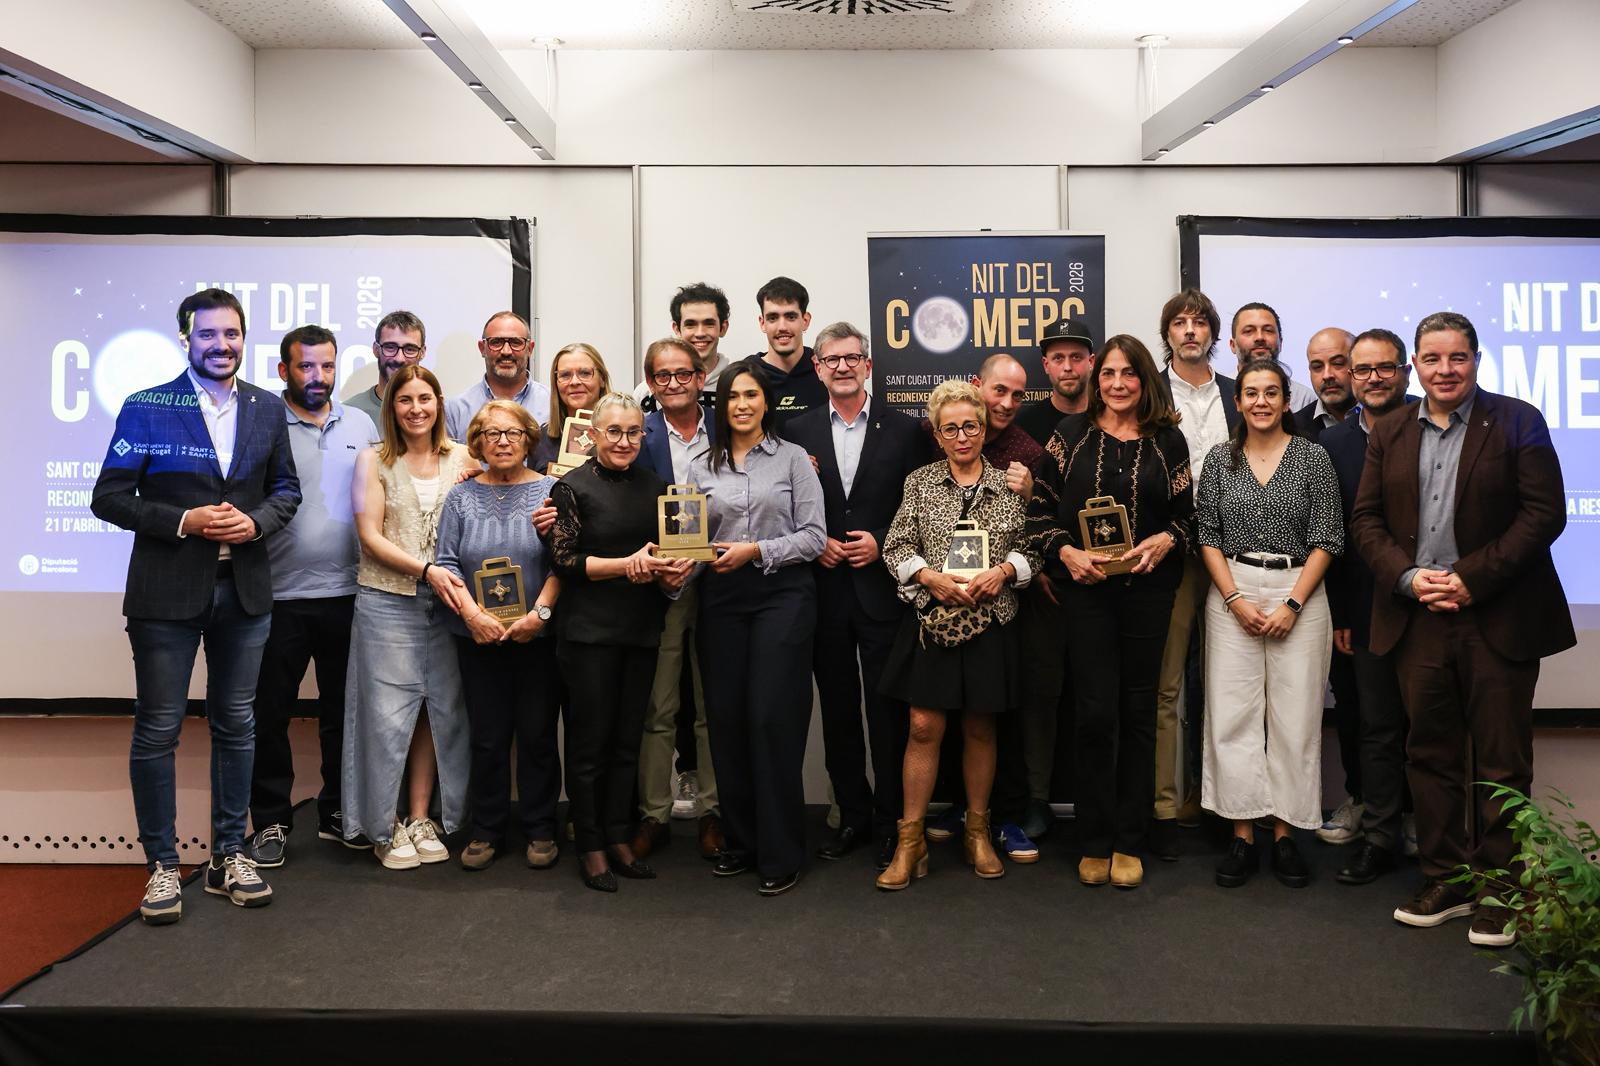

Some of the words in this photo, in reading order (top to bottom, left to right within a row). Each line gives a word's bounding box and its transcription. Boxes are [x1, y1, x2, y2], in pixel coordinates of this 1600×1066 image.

[971, 263, 1009, 293] NIT
[1016, 263, 1060, 293] DEL
[1069, 262, 1084, 292] 2026
[270, 283, 341, 331] DEL
[357, 276, 382, 329] 2026
[1503, 282, 1568, 332] NIT
[886, 374, 905, 385] SANT
[908, 374, 932, 385] CUGAT
[46, 461, 80, 478] SANT
[46, 518, 60, 532] 21
[62, 518, 105, 532] D'ABRIL
